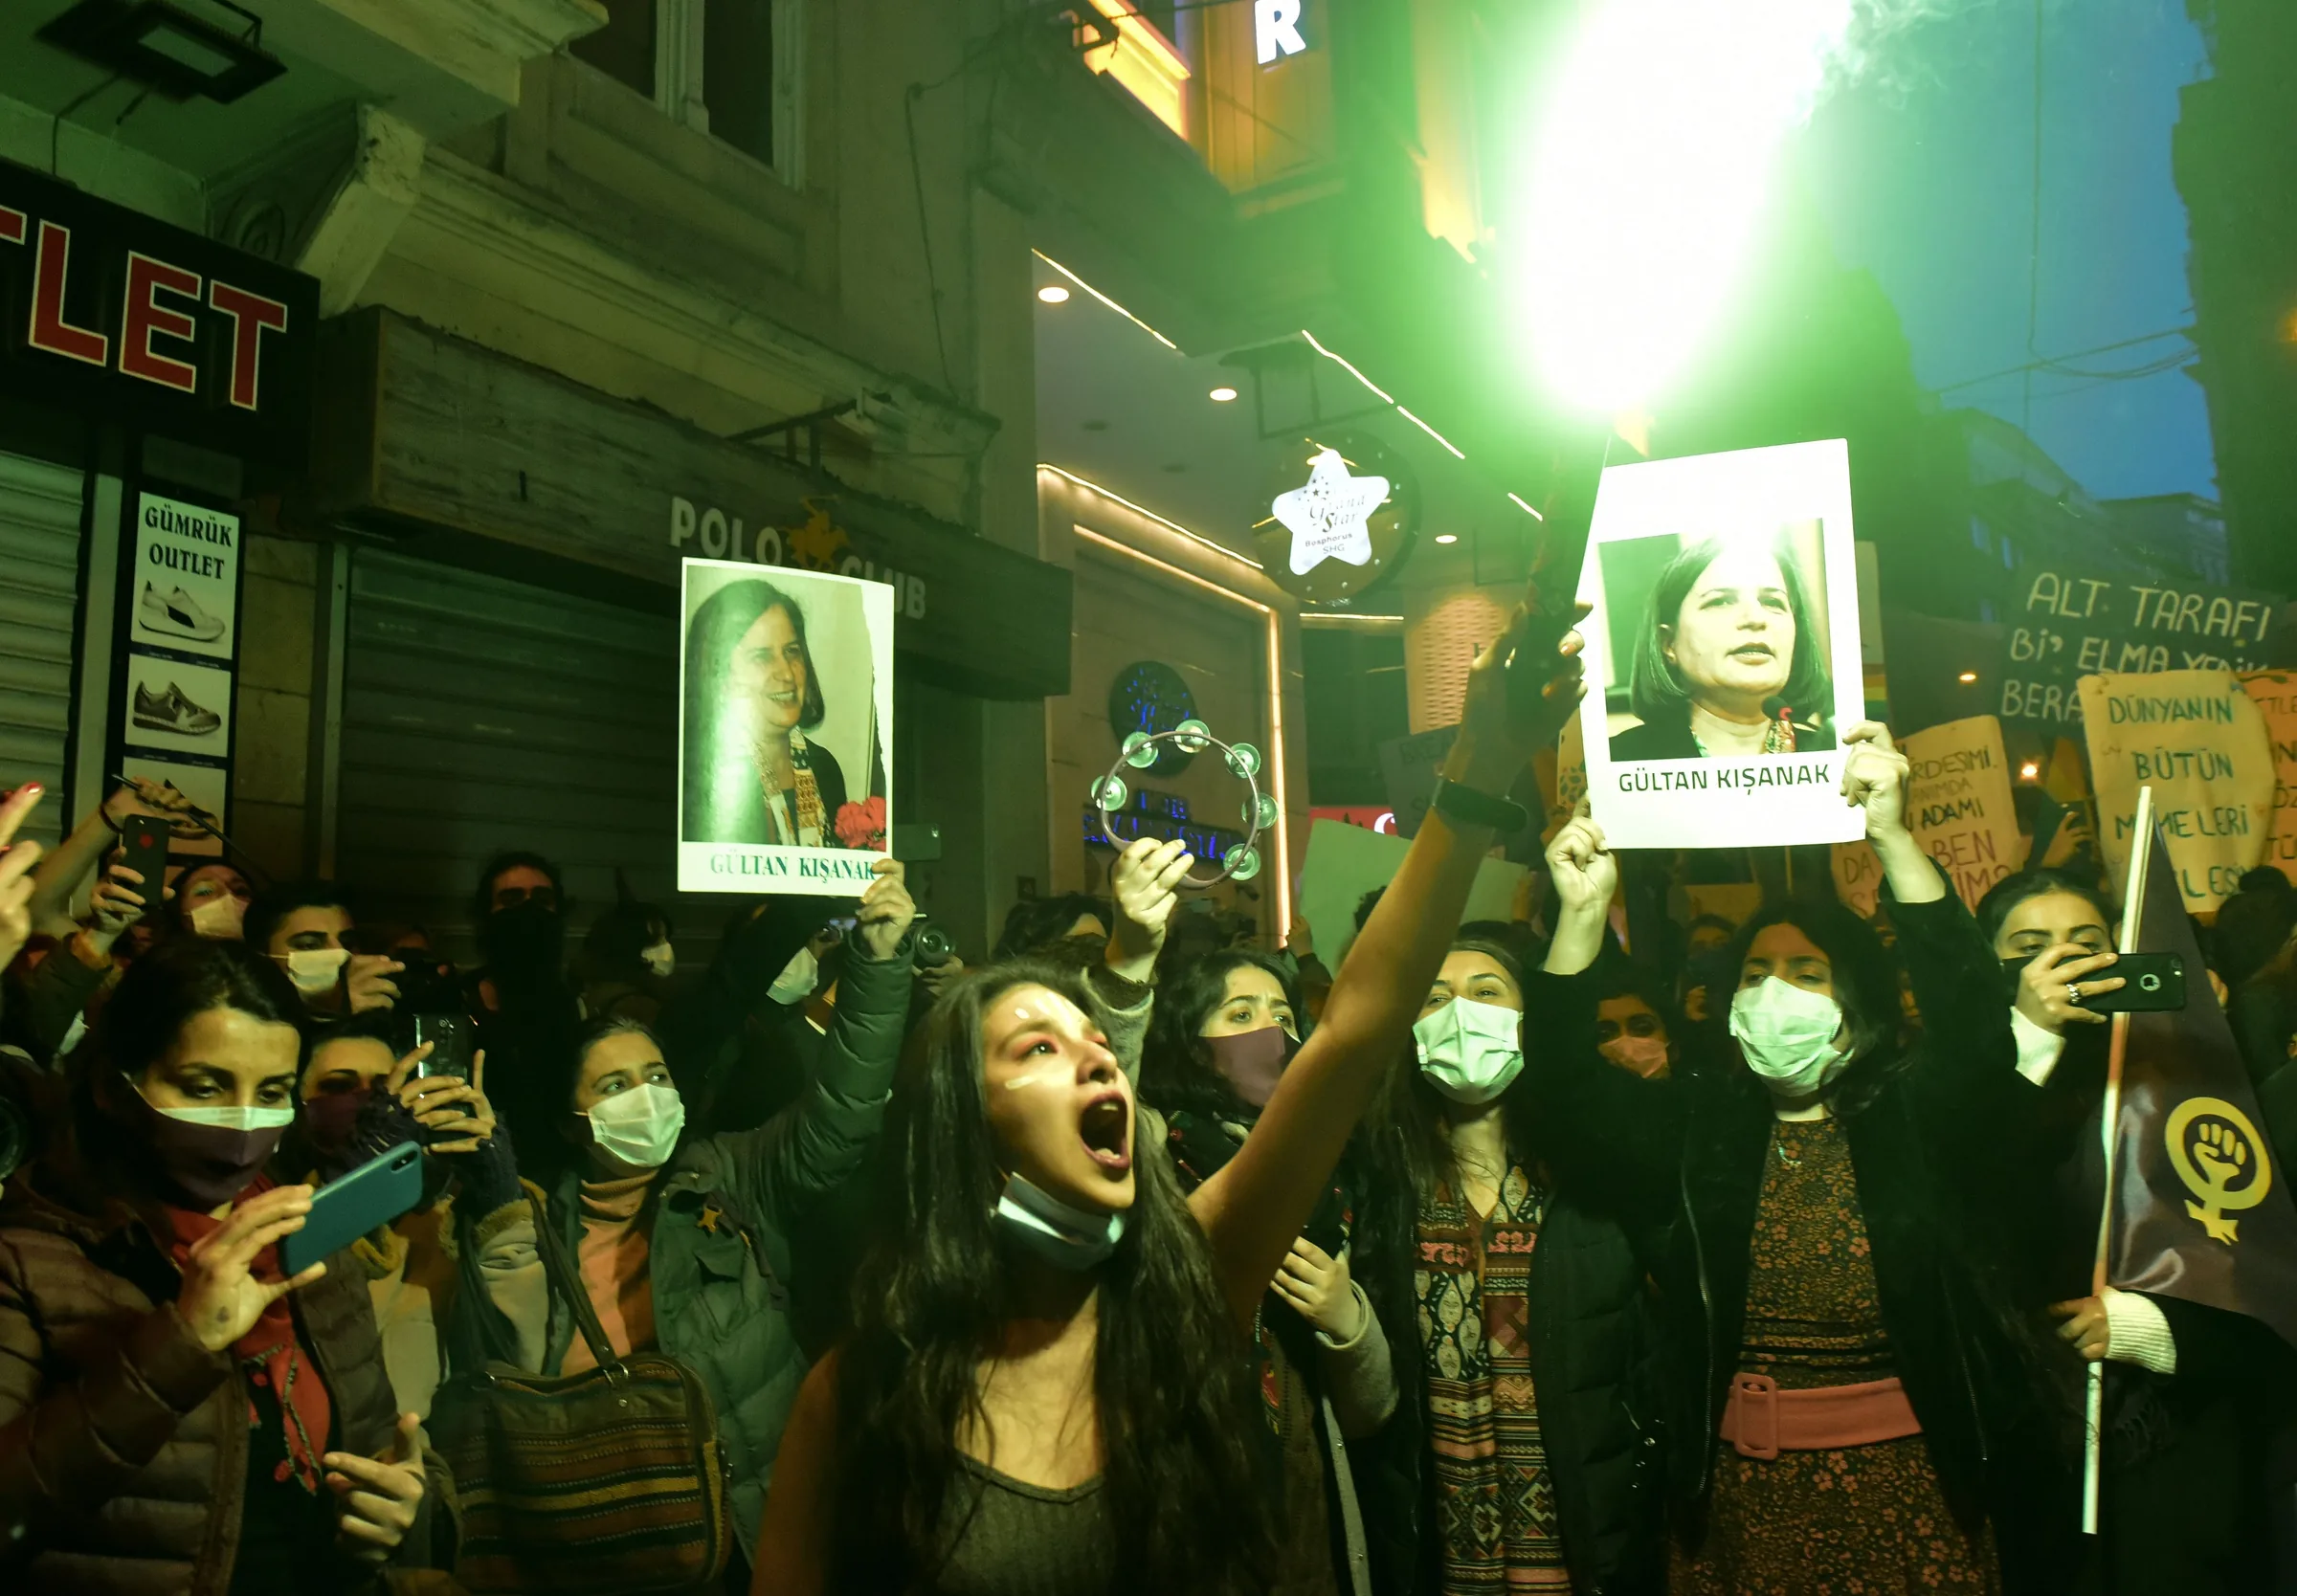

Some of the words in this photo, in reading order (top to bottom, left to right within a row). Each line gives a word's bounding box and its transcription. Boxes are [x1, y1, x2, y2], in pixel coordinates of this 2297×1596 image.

[0, 204, 287, 411] LET
[145, 503, 234, 547] GÜMRÜK
[671, 496, 783, 566] POLO
[148, 542, 226, 581] OUTLET
[2026, 572, 2111, 618] ALT
[2130, 586, 2272, 642] TARAFI
[2076, 636, 2170, 674] ELMA
[2108, 695, 2234, 725] DÜNYANIN
[1618, 767, 1707, 793] GÜLTAN
[1717, 764, 1830, 796] KIŞANAK
[2130, 746, 2234, 782] BÜTÜN
[1921, 797, 1985, 831] ADAMI
[710, 849, 788, 876] GÜLTAN
[799, 856, 877, 883] KIŞANAK
[1932, 829, 1998, 869] BEN
